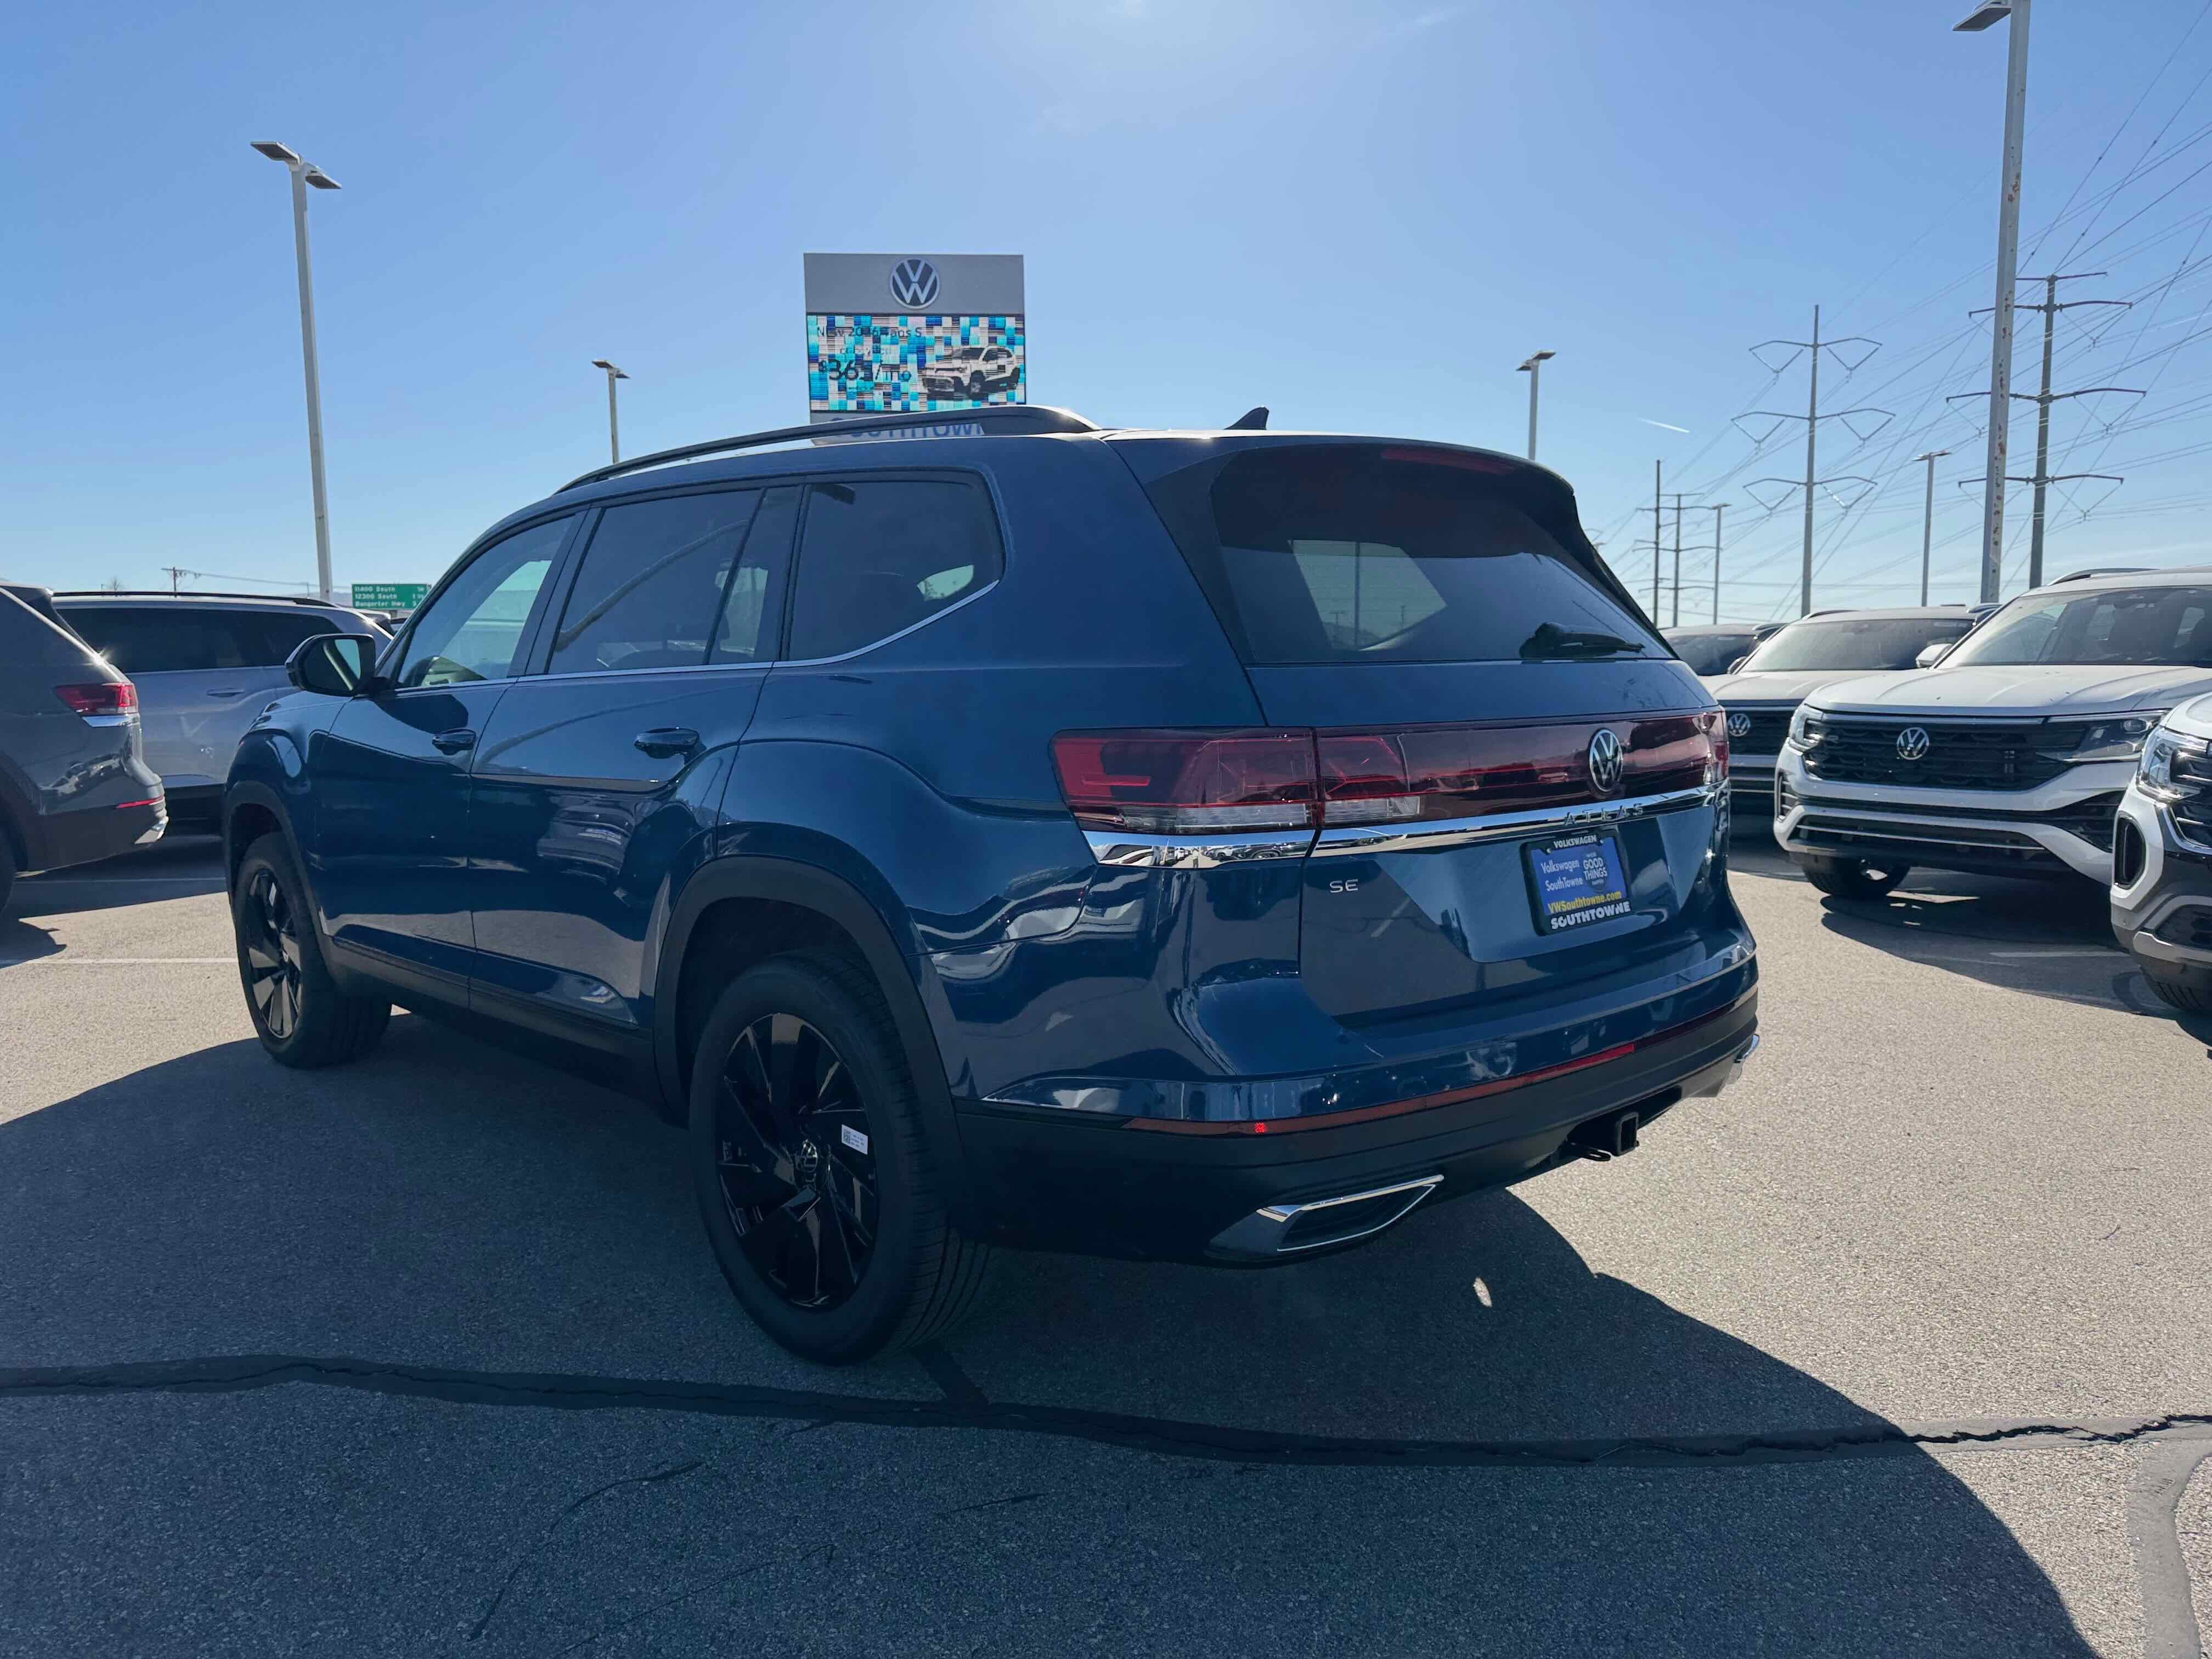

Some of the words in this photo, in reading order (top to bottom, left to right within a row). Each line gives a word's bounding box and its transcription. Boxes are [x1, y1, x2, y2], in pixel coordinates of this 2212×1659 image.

[891, 258, 938, 307] VW
[1589, 729, 1623, 792] VW
[1564, 803, 1644, 826] ATLAS
[1554, 834, 1597, 849] VOLKSWAGEN
[1541, 860, 1580, 874] Volkswagen
[1583, 857, 1603, 870] GOOD
[1583, 867, 1607, 881] THINGS
[1329, 879, 1358, 893] SE
[1545, 877, 1583, 891] SouthTowne
[1550, 901, 1631, 930] SOUTHTOWNE
